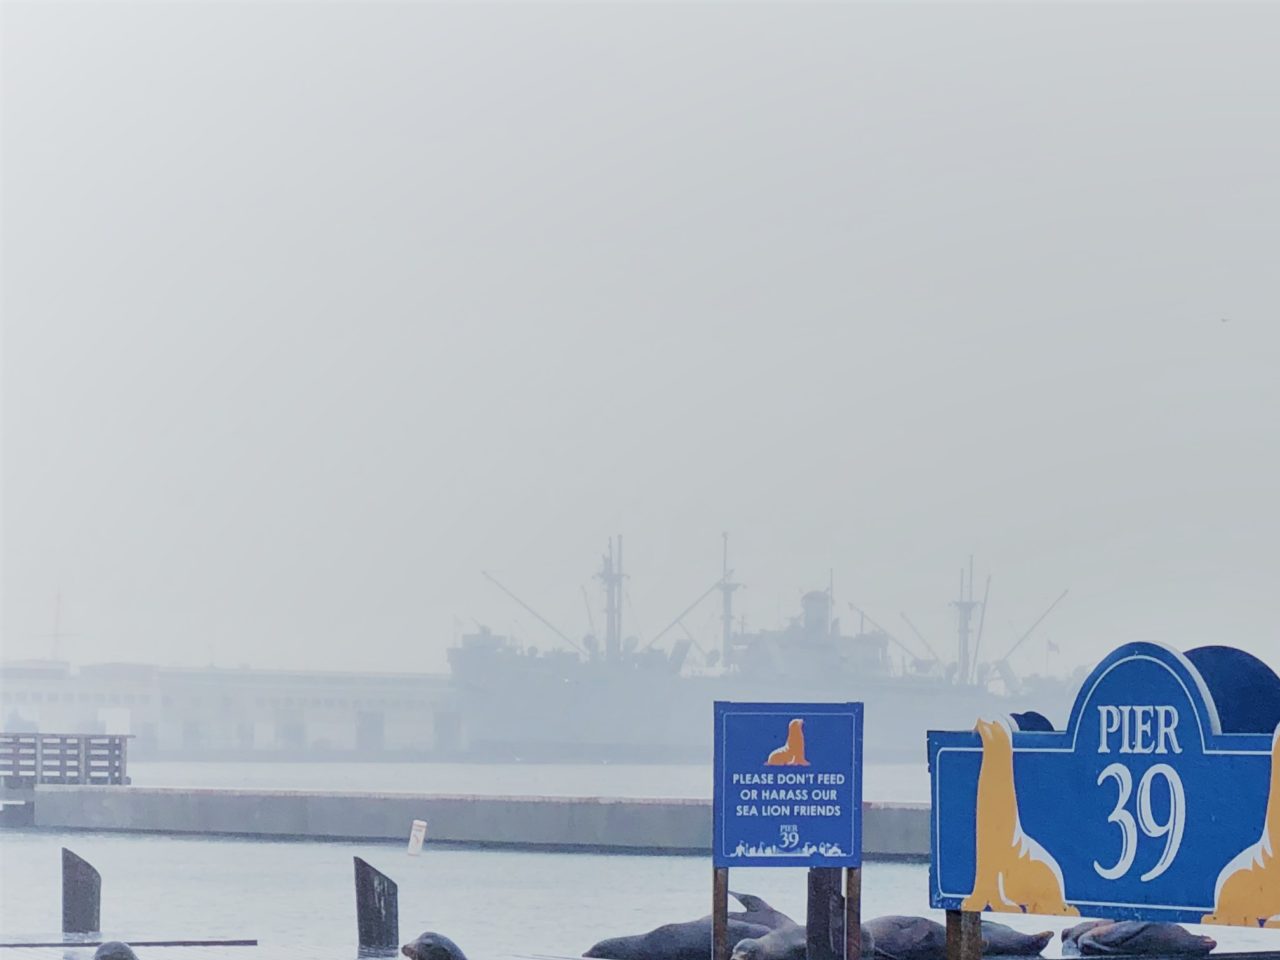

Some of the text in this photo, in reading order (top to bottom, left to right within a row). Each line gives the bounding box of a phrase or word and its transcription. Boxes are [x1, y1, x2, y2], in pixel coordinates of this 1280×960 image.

[1097, 704, 1183, 755] PIER
[733, 773, 845, 785] PLEASE DON'T FEED
[740, 789, 837, 800] OR HARASS OUR
[736, 805, 841, 817] SEA LION FRIENDS
[780, 824, 798, 832] PIER
[1093, 762, 1186, 882] 39
[779, 832, 799, 848] 39
